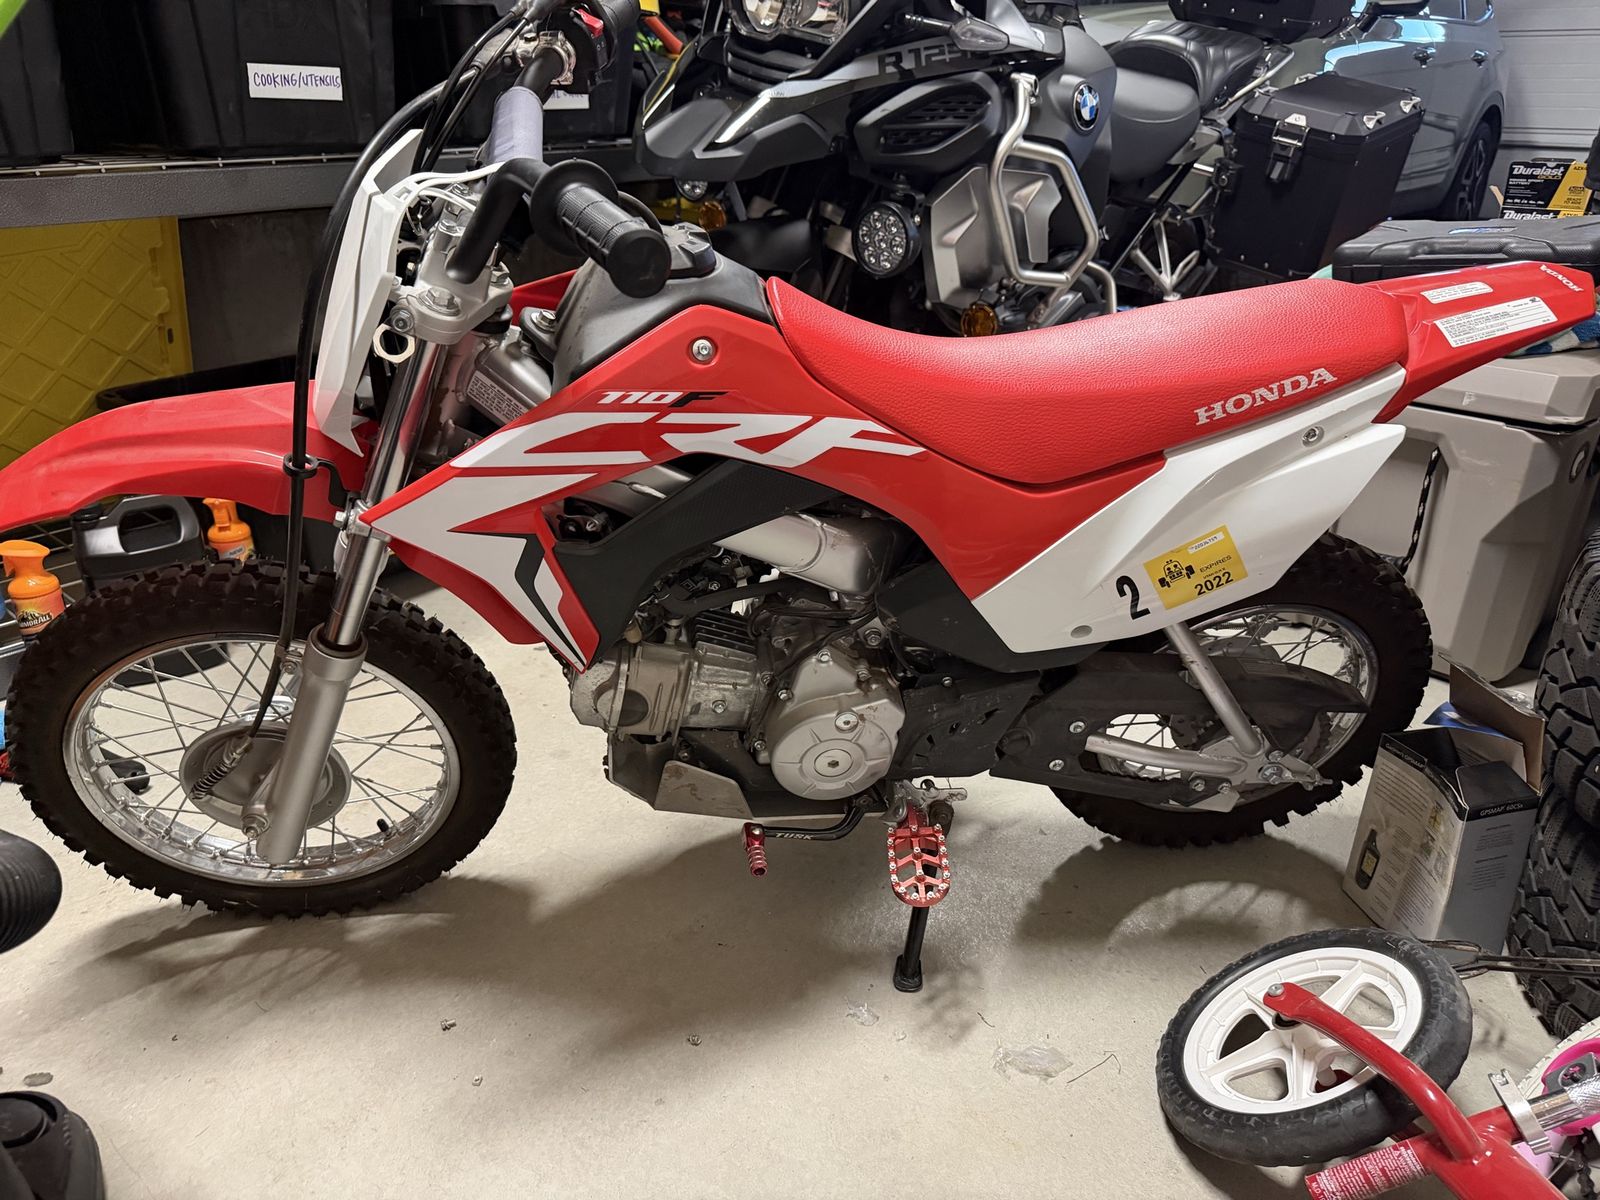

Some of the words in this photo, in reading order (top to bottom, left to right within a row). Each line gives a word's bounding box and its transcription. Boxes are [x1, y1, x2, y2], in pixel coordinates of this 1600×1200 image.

[253, 72, 341, 89] COOKING/UTENSILS
[1512, 165, 1565, 176] Duralast
[1540, 264, 1584, 292] HONDA
[1193, 367, 1338, 426] HONDA
[449, 412, 928, 468] CRF
[1199, 554, 1232, 573] EXPIRES
[1194, 571, 1234, 596] 2022
[1115, 575, 1151, 621] 2
[775, 832, 816, 840] TUSK
